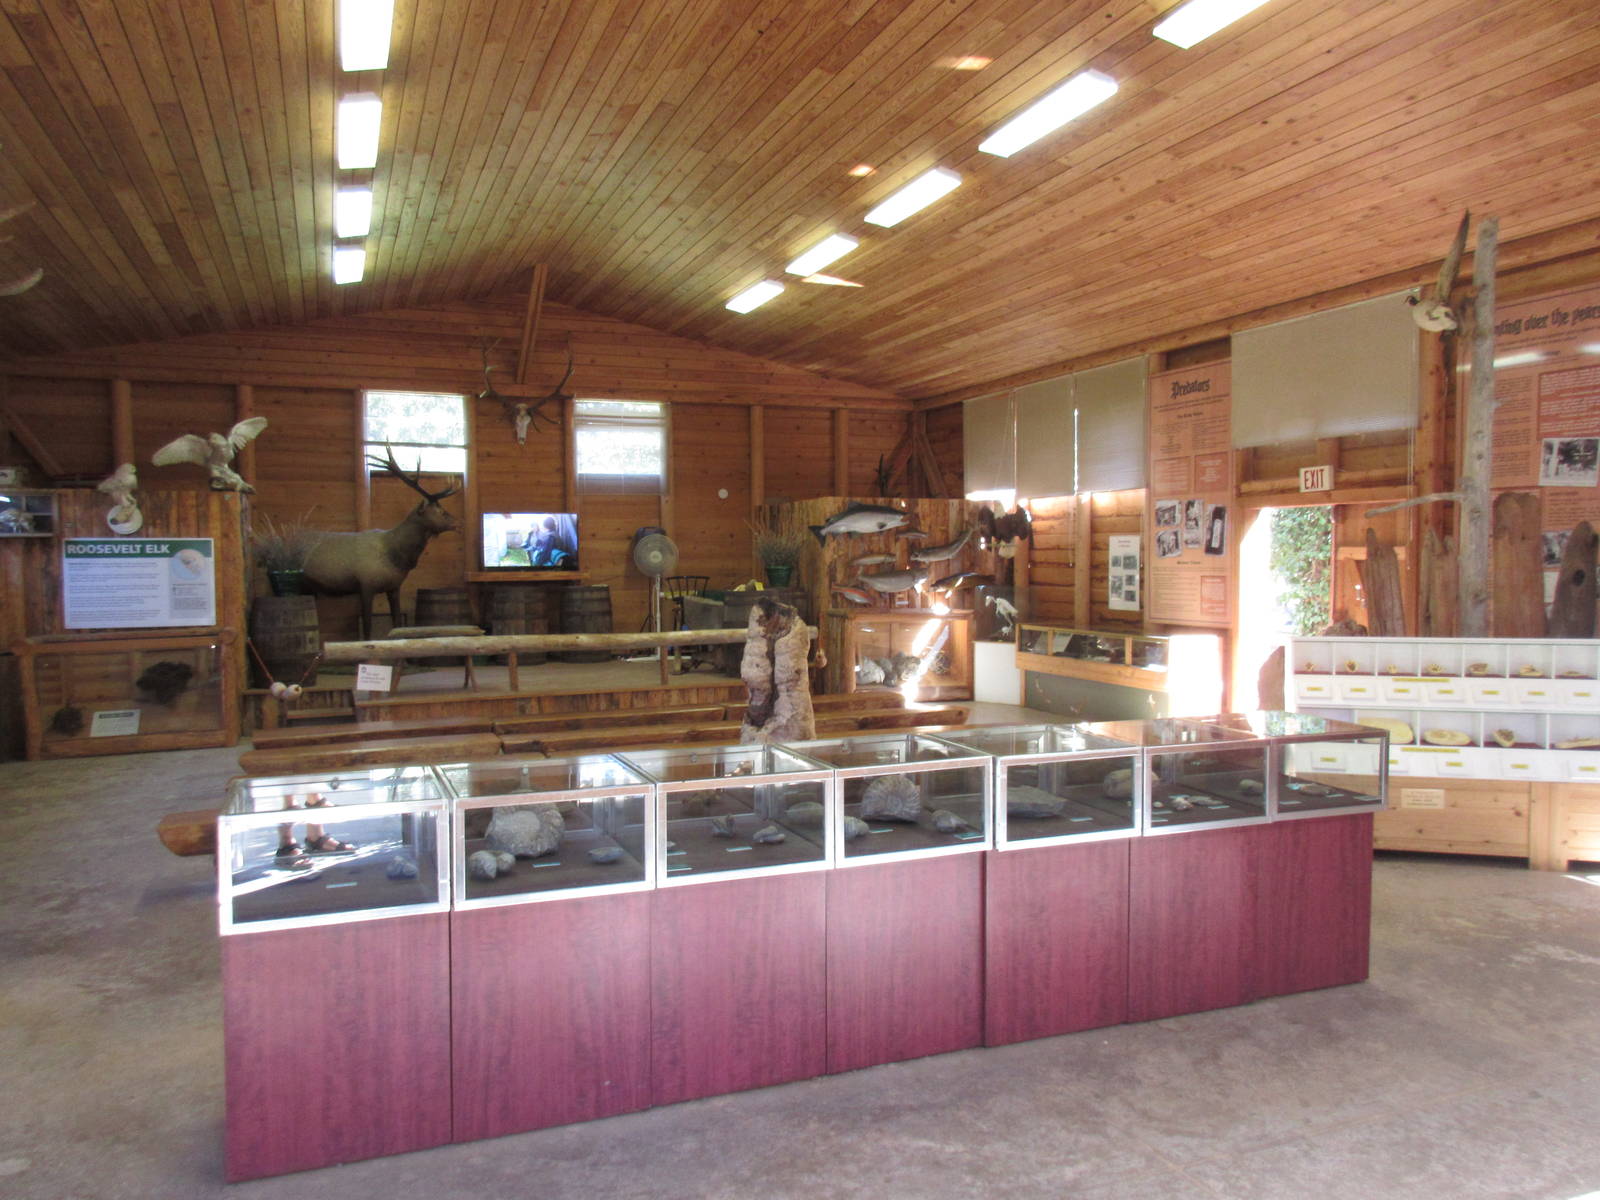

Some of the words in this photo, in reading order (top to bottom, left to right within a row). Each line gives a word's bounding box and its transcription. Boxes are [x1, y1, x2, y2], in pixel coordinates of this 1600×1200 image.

[1524, 314, 1549, 331] over
[1551, 307, 1569, 327] the
[1170, 379, 1210, 399] Predators
[1303, 469, 1325, 489] EXIT
[67, 544, 142, 554] ROOSEVELT
[145, 544, 170, 554] ELK
